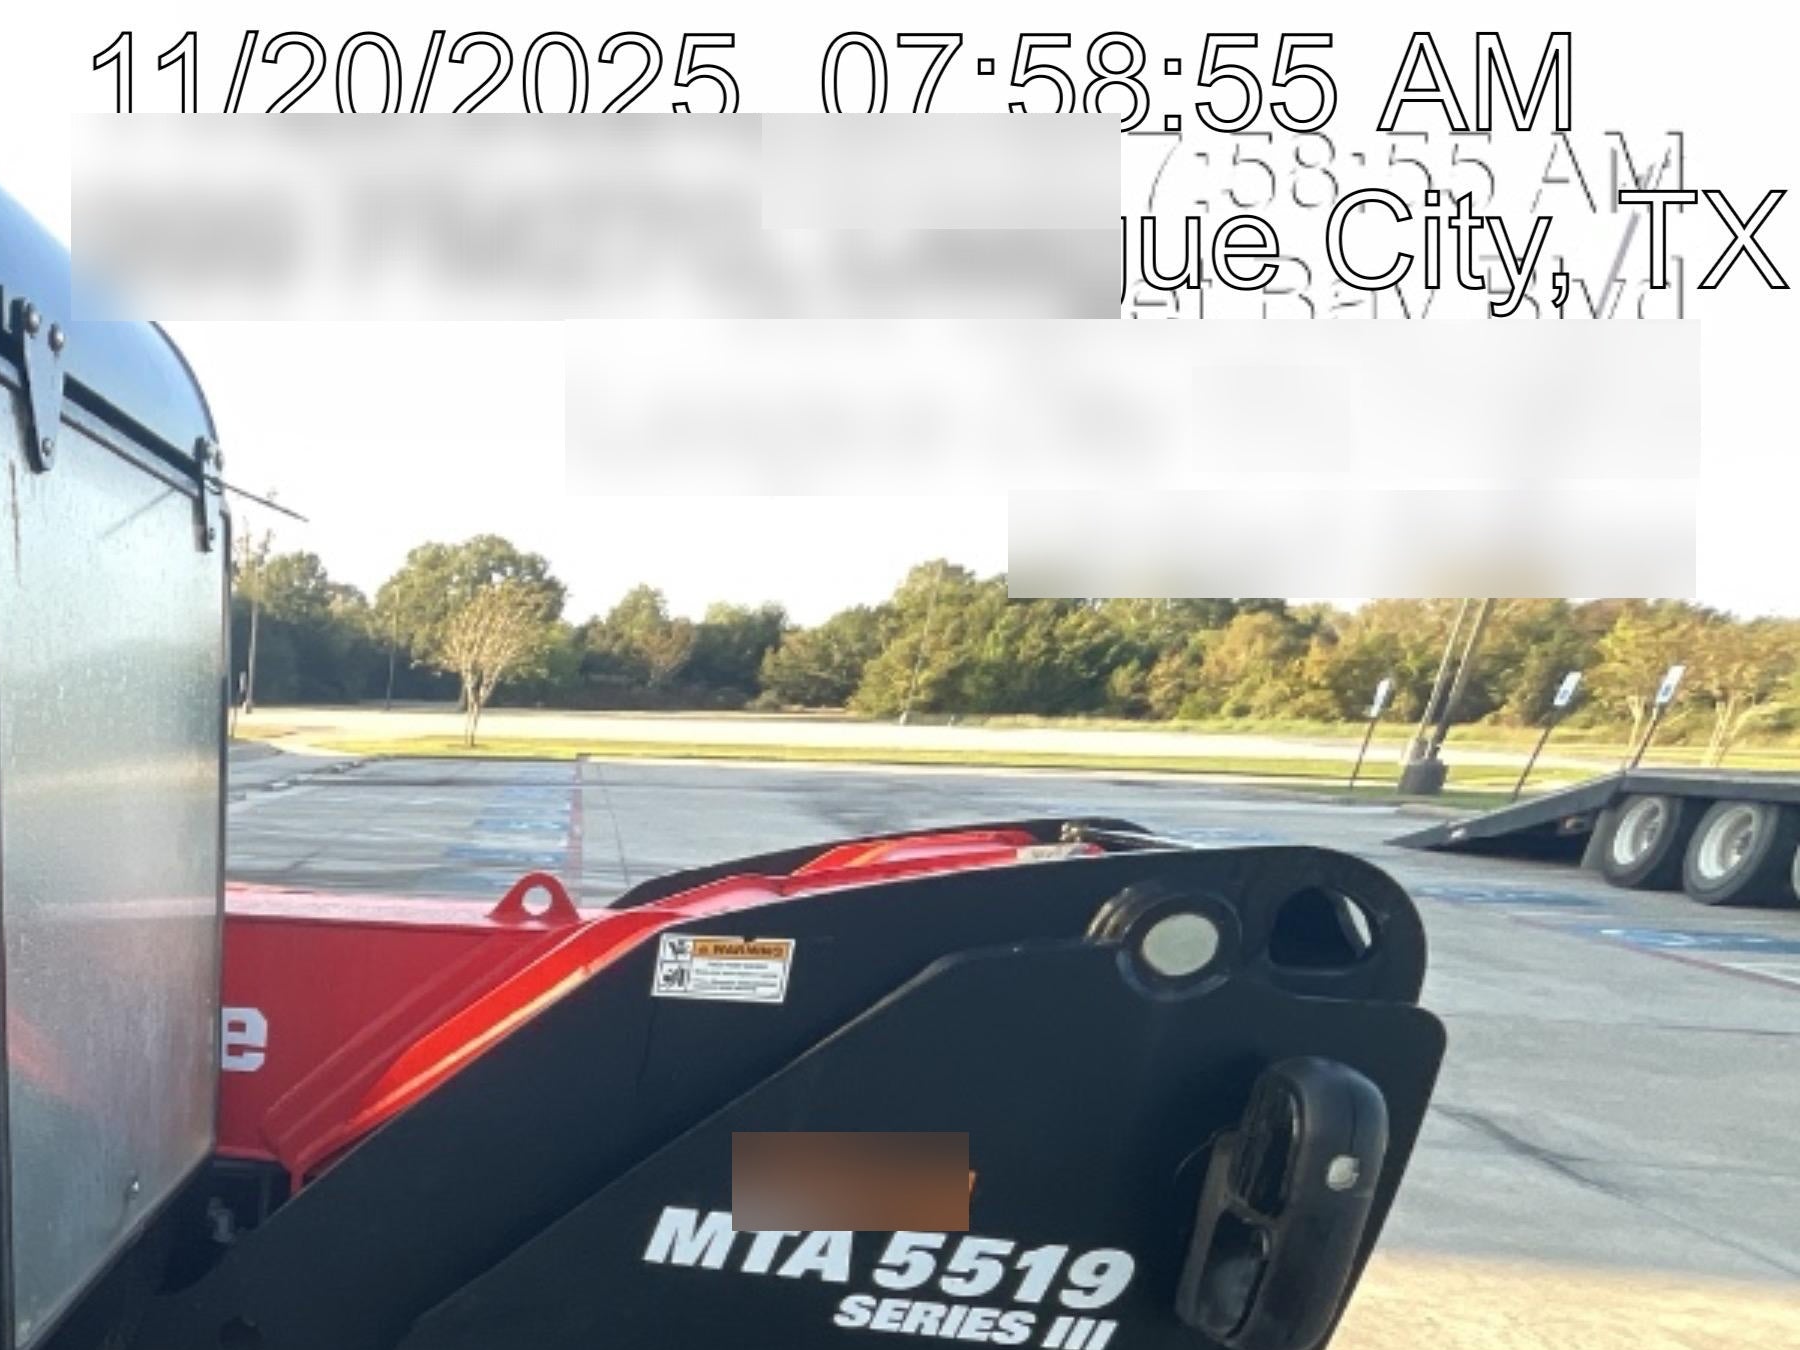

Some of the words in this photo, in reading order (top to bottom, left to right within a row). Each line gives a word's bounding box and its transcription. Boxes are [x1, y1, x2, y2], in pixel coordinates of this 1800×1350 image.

[641, 1204, 855, 1284] MTA
[872, 1230, 1137, 1311] 5519
[832, 1293, 1038, 1346] SERIES
